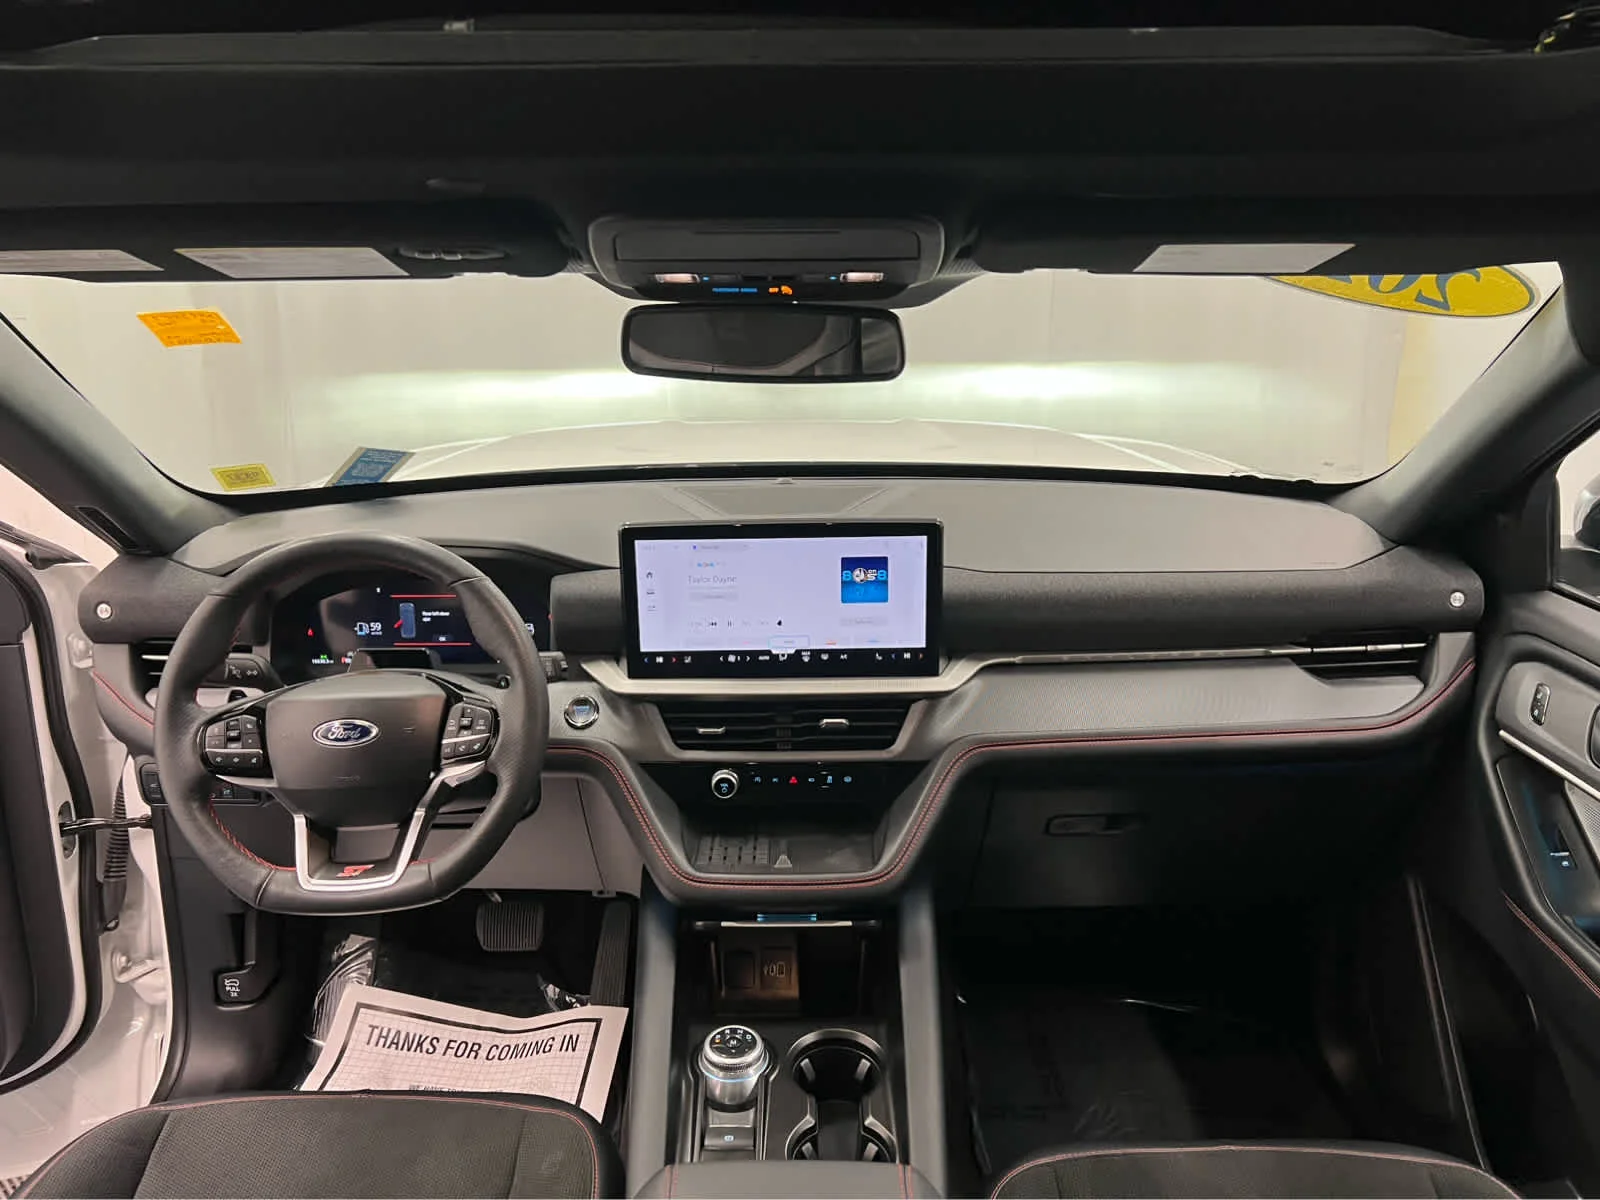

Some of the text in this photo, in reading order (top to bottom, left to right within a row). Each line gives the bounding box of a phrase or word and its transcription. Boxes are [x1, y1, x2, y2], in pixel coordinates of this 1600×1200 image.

[369, 622, 382, 631] 59
[327, 727, 361, 740] Ford
[366, 1024, 580, 1061] THANKS FOR COMING IN
